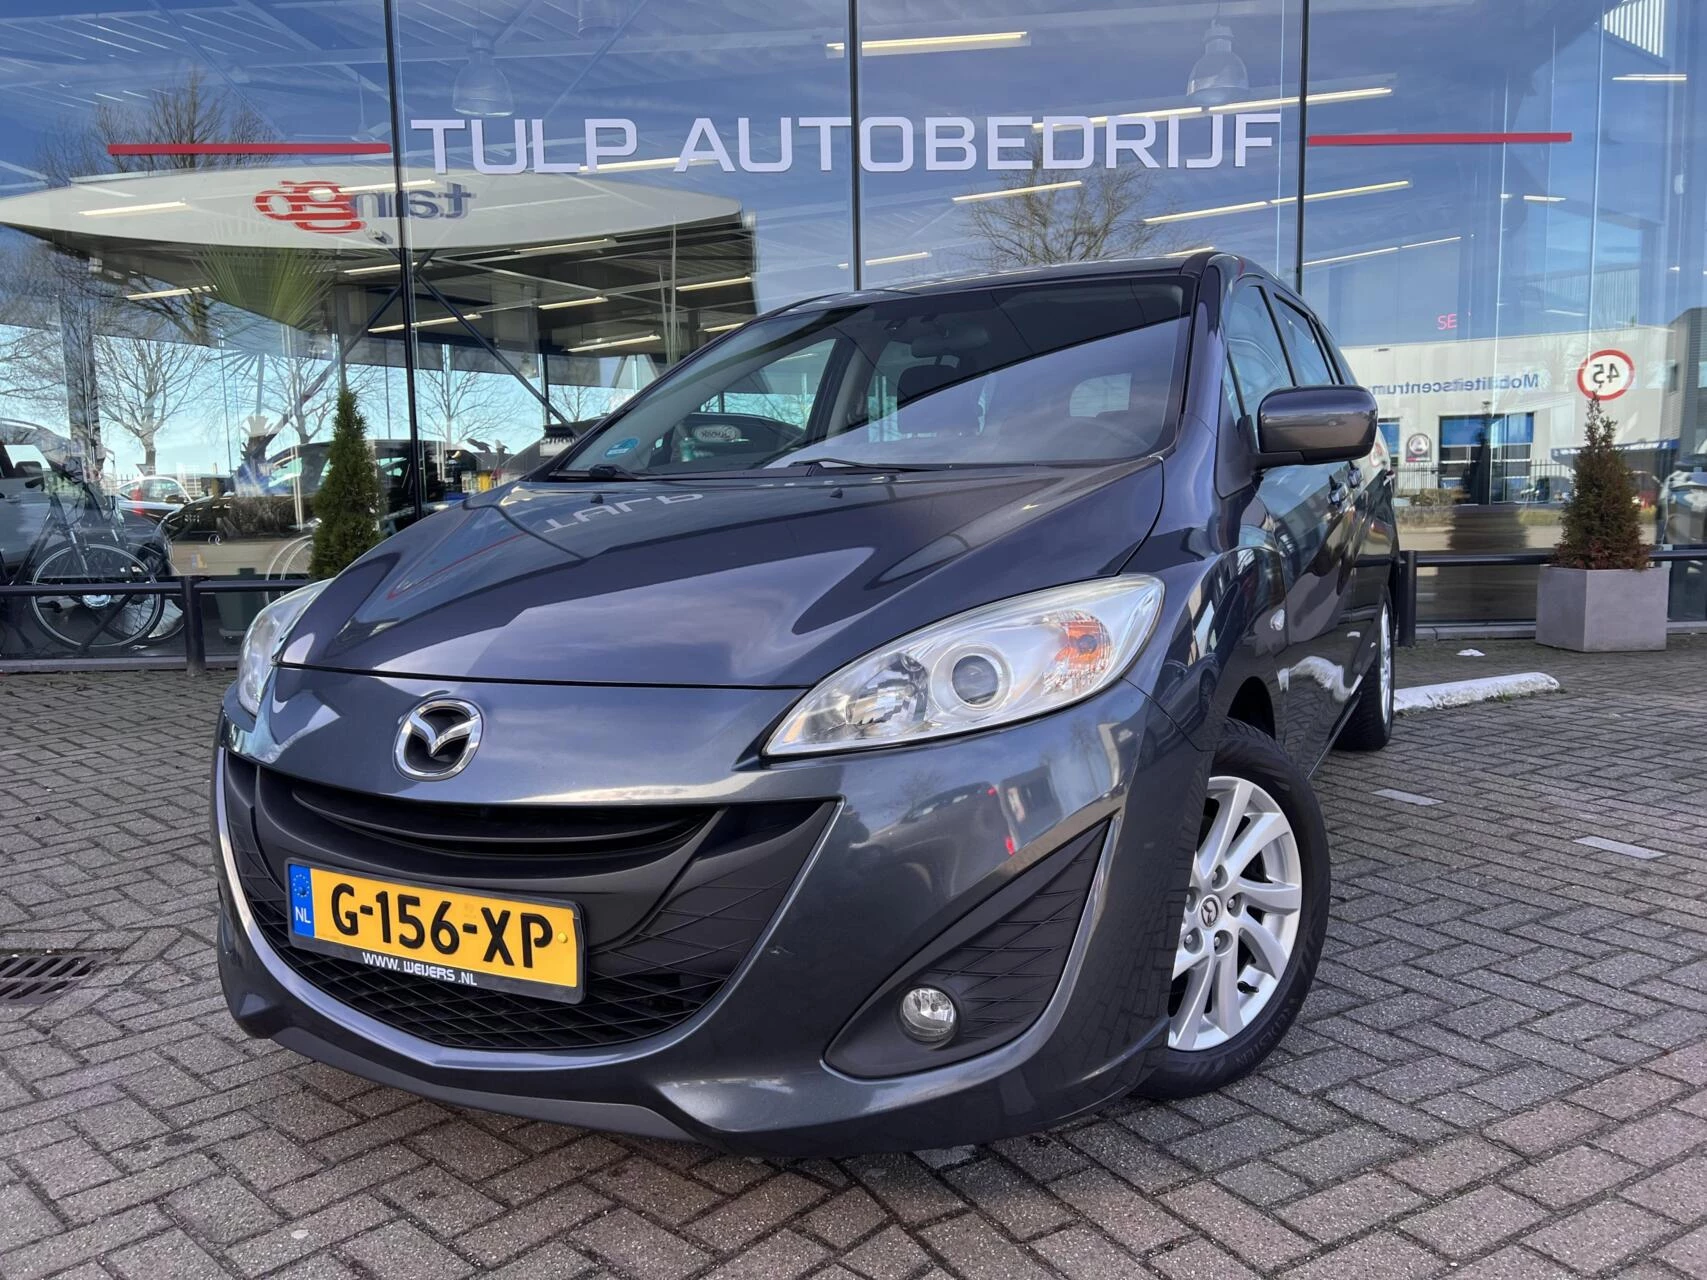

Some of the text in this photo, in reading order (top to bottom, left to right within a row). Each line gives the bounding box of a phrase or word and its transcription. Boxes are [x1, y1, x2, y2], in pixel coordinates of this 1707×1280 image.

[411, 113, 1280, 174] TULP AUTOBEDRIJF
[295, 905, 312, 924] NL
[331, 883, 553, 968] G-156-XP
